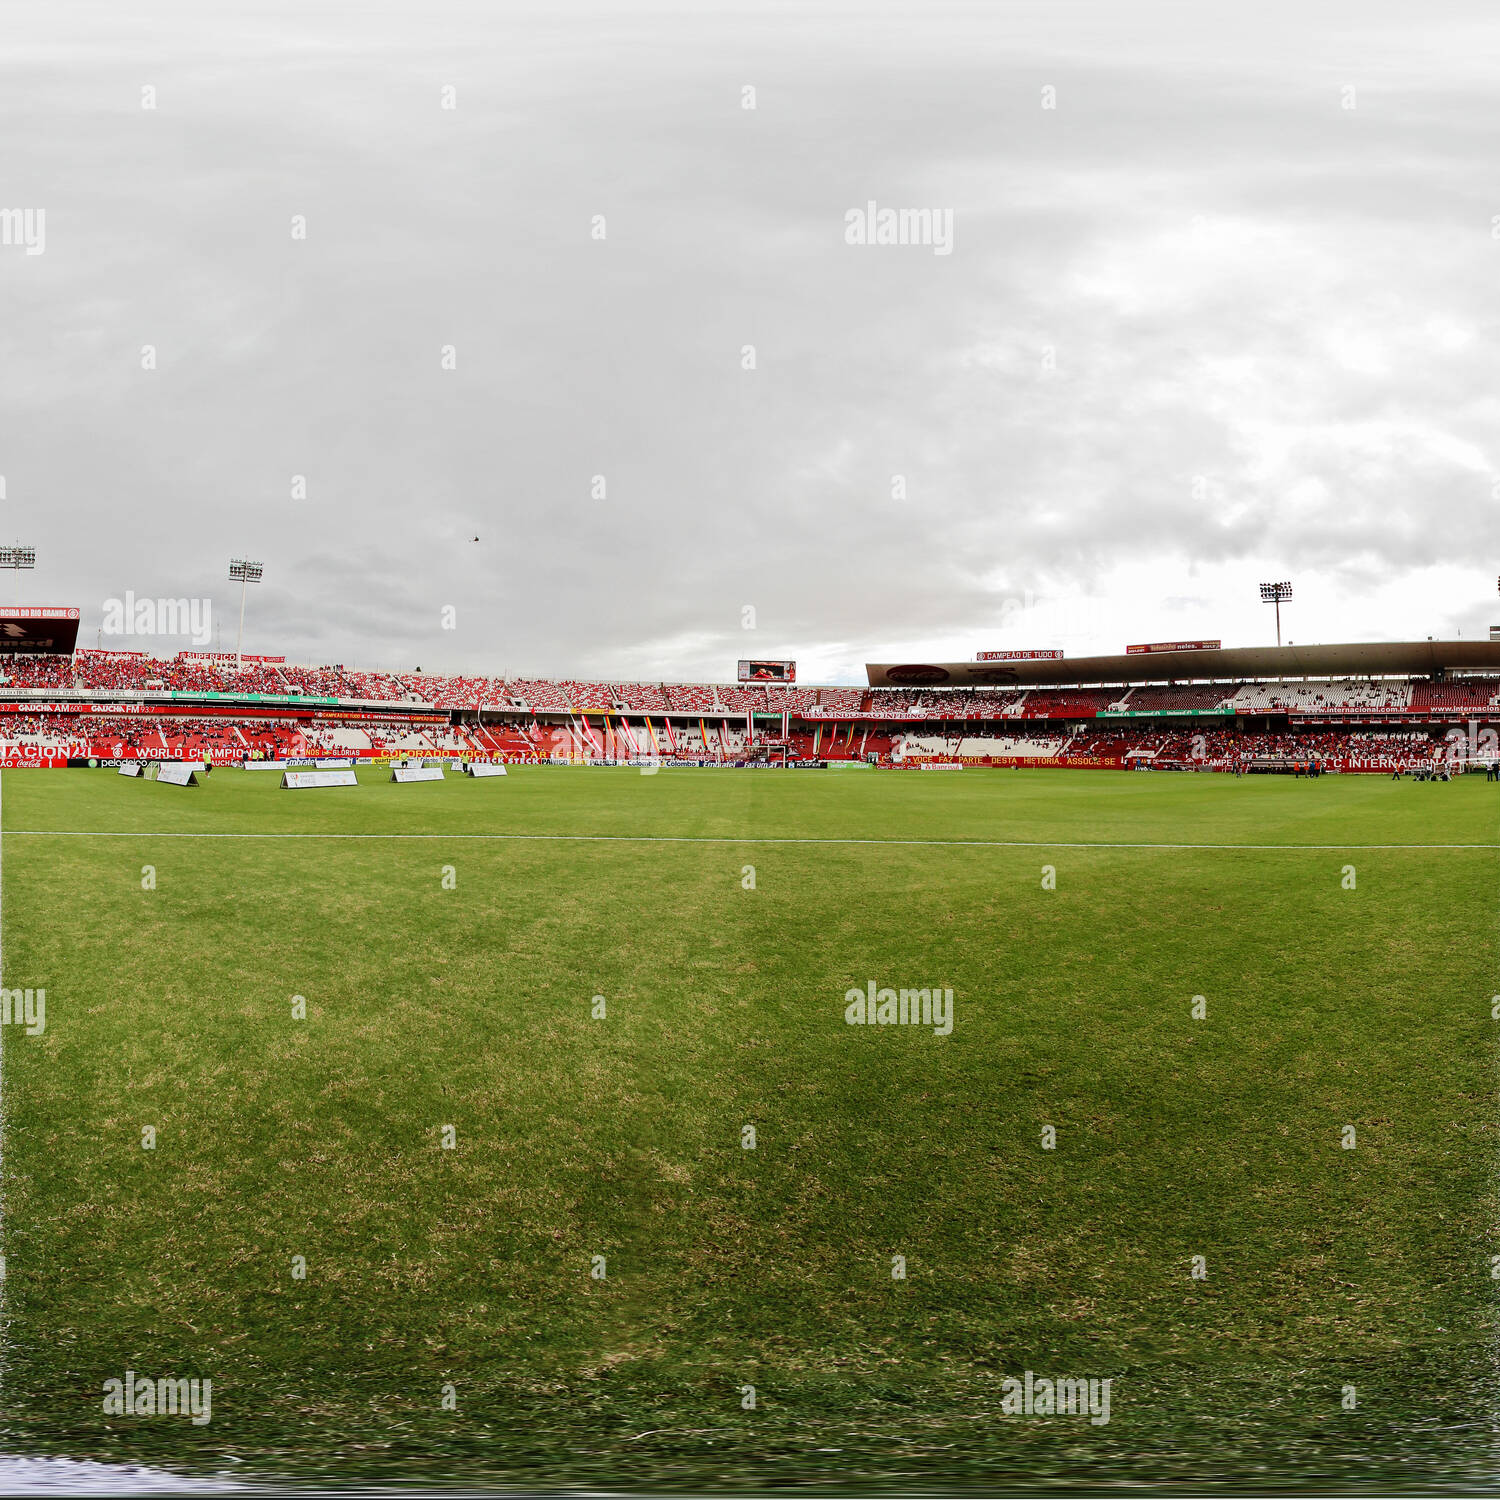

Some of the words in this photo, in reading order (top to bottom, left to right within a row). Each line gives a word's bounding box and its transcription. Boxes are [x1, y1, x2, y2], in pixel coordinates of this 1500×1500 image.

[187, 652, 236, 661] SUPERFICO
[987, 651, 1021, 659] CAMPEÃO
[1022, 651, 1032, 659] DE
[1034, 650, 1053, 658] TUDO
[126, 705, 140, 713] FM
[136, 748, 182, 758] WORLD
[17, 759, 42, 768] Coca-Cola
[991, 757, 1018, 765] DESTA
